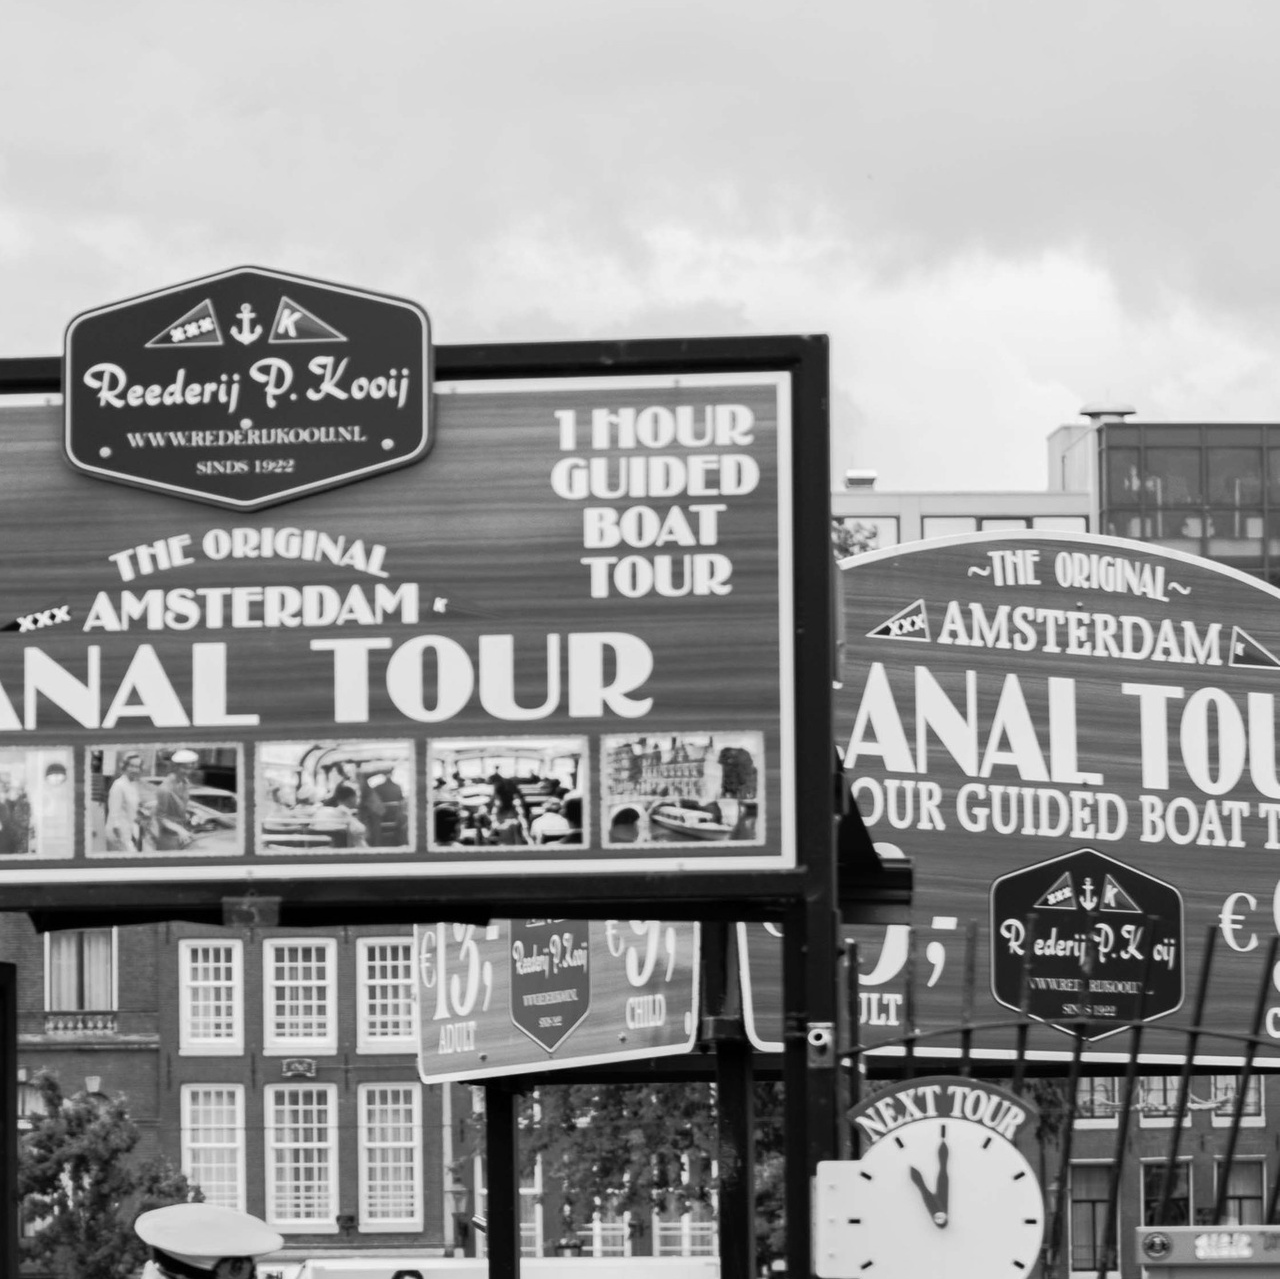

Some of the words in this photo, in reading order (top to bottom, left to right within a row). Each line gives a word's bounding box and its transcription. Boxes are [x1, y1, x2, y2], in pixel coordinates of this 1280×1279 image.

[83, 363, 241, 413] Reederij
[306, 355, 410, 409] Kooij
[554, 409, 576, 450] 1
[591, 404, 756, 450] HOUR
[196, 460, 249, 476] SINDS
[254, 458, 296, 474] 1922
[550, 454, 760, 500] GUIDED
[583, 504, 727, 549] BOAT
[108, 533, 195, 582] THE
[202, 527, 390, 578] ORIGINAL
[580, 553, 733, 598] TOUR
[82, 582, 420, 632] AMSTERDAM
[936, 600, 1223, 666] AMSTERDAM
[310, 632, 654, 723] TOUR
[841, 662, 1105, 786] ANAL
[850, 776, 946, 831] OUR
[956, 783, 1128, 841] GUIDED
[1139, 794, 1250, 848] BOAT
[1000, 918, 1087, 966] Rederij
[1120, 924, 1176, 970] Koij
[625, 993, 667, 1030] CHILD
[1062, 1004, 1092, 1015] SINS
[437, 1020, 477, 1055] ADULT
[856, 1086, 943, 1142] NEXT
[948, 1084, 1026, 1142] TOUR
